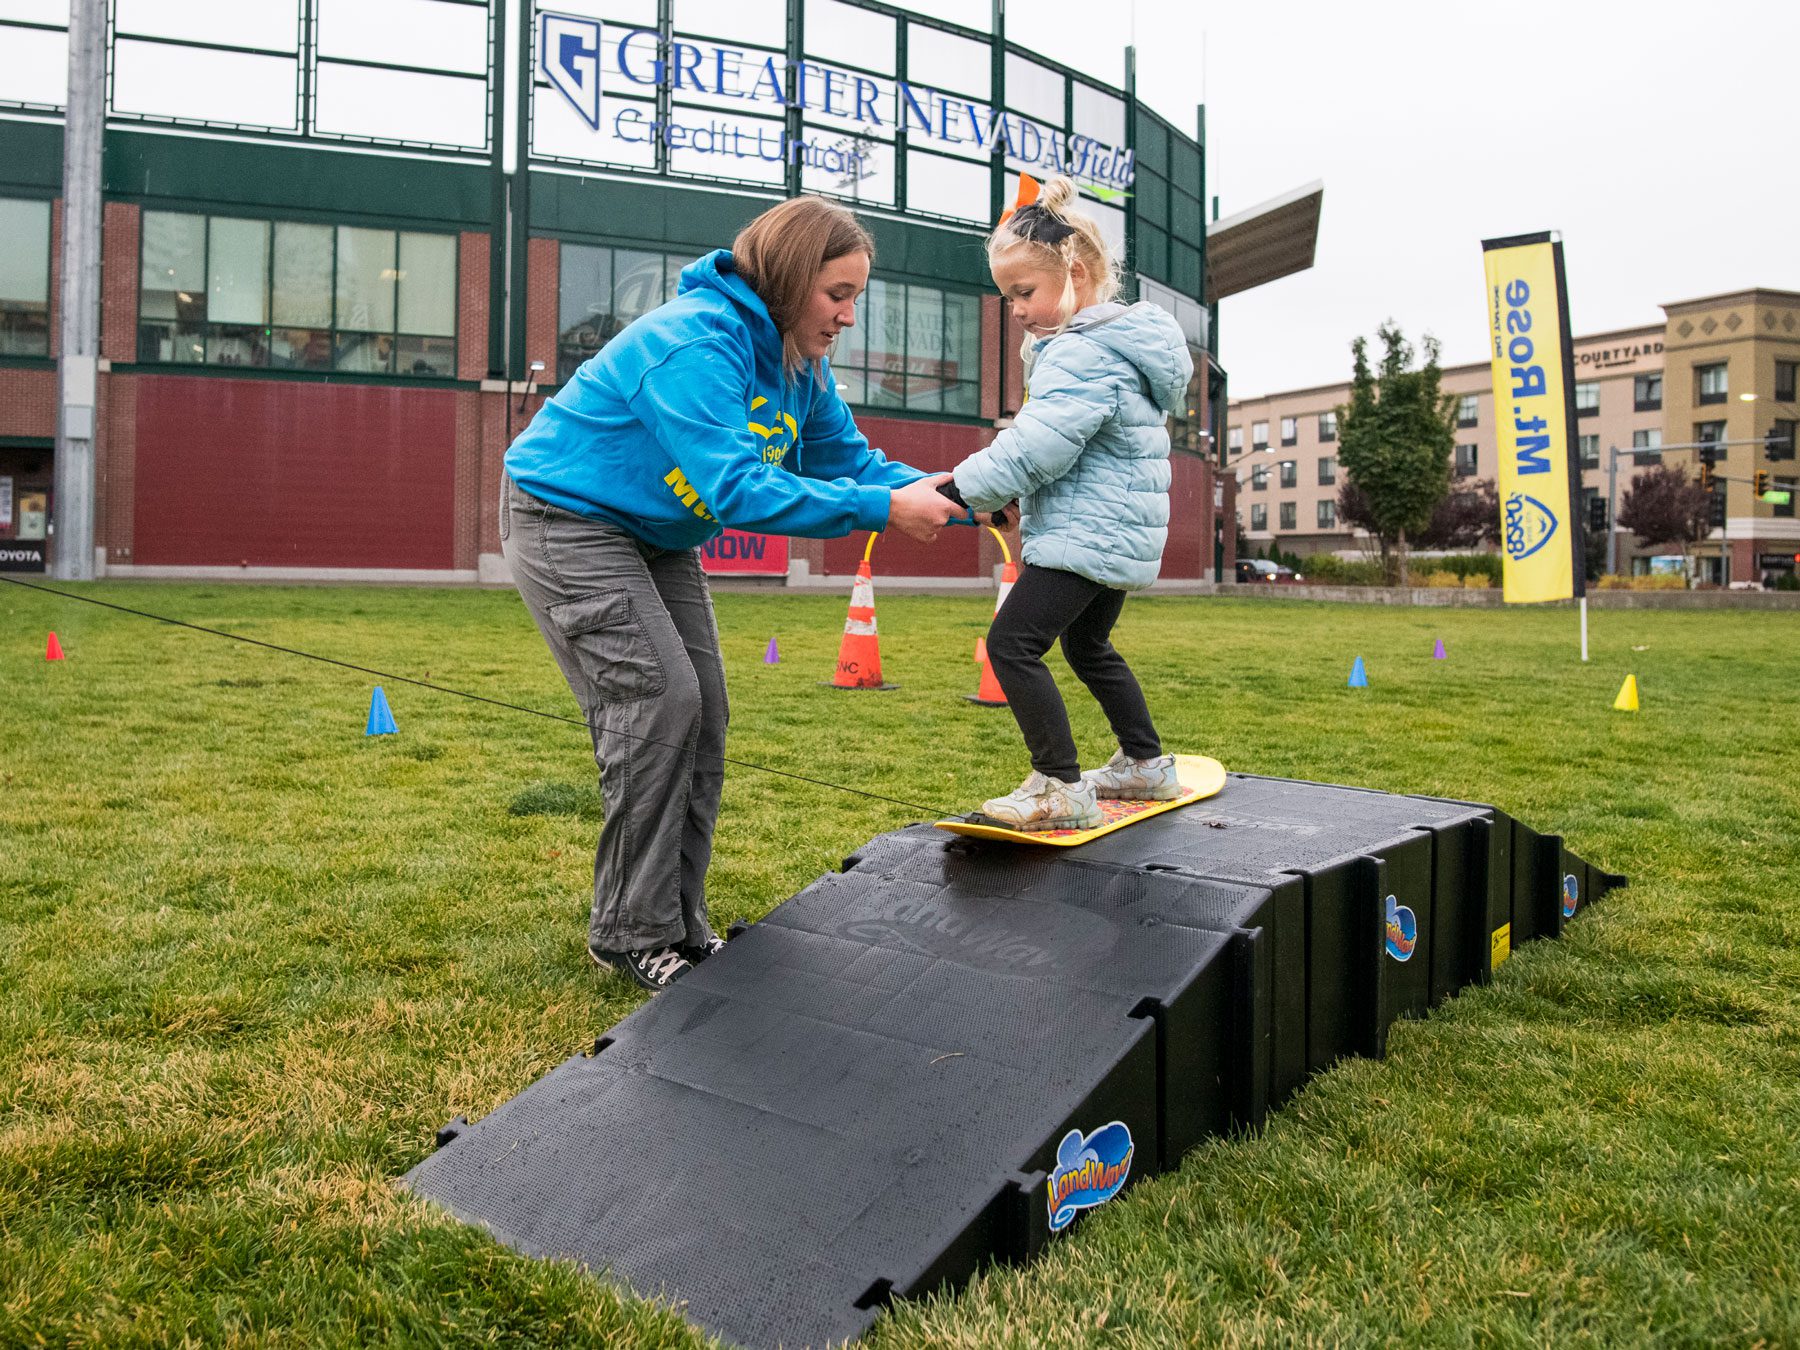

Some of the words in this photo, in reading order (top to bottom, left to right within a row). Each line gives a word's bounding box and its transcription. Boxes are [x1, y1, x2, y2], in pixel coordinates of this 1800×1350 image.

[616, 29, 883, 126] GREATER
[898, 81, 1065, 174] NEVADA
[1067, 134, 1134, 187] Field
[612, 108, 745, 158] Credit
[759, 127, 864, 180] Union
[884, 327, 953, 354] NVADA
[701, 536, 767, 560] NOW
[1047, 1146, 1133, 1214] LandWave
